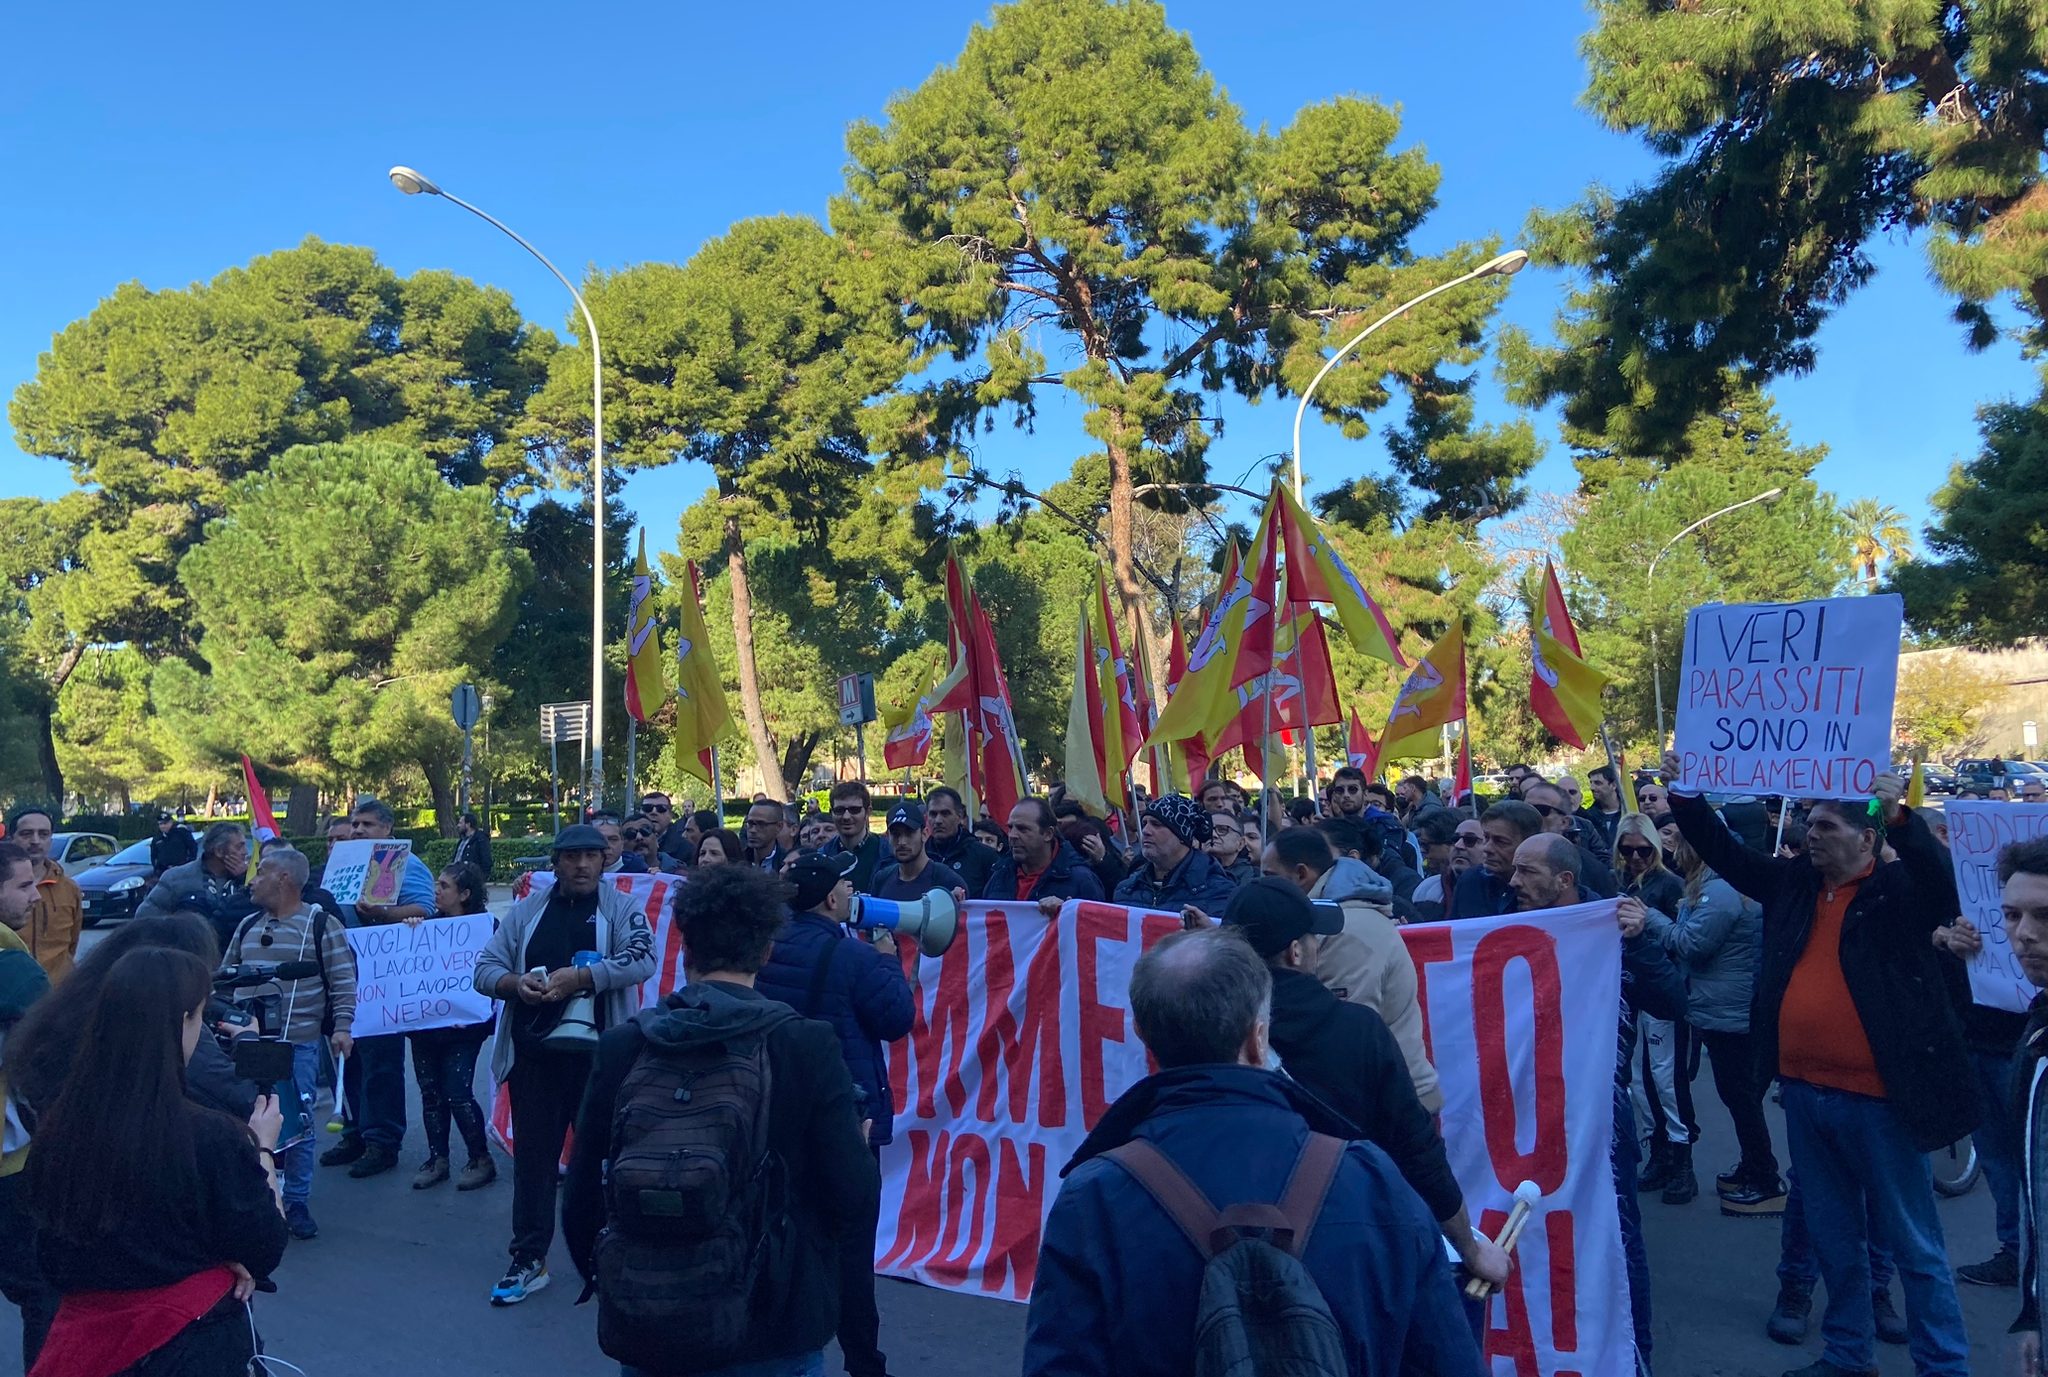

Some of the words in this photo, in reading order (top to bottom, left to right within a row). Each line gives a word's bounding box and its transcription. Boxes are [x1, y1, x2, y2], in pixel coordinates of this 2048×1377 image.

[1693, 613, 1700, 666] I
[1718, 606, 1826, 664] VERI
[842, 678, 856, 704] M
[1689, 666, 1865, 716] PARASSITI
[1709, 717, 1809, 752] SONO
[1823, 720, 1852, 752] IN
[1682, 751, 1877, 794] PARLAMENTO
[1950, 811, 2048, 855] REDDIT
[352, 921, 471, 959] VOGLIAMO
[374, 955, 434, 980] LAVORO
[400, 975, 473, 998] LAVORO
[382, 999, 451, 1028] NERO
[875, 1128, 1046, 1301] NON
